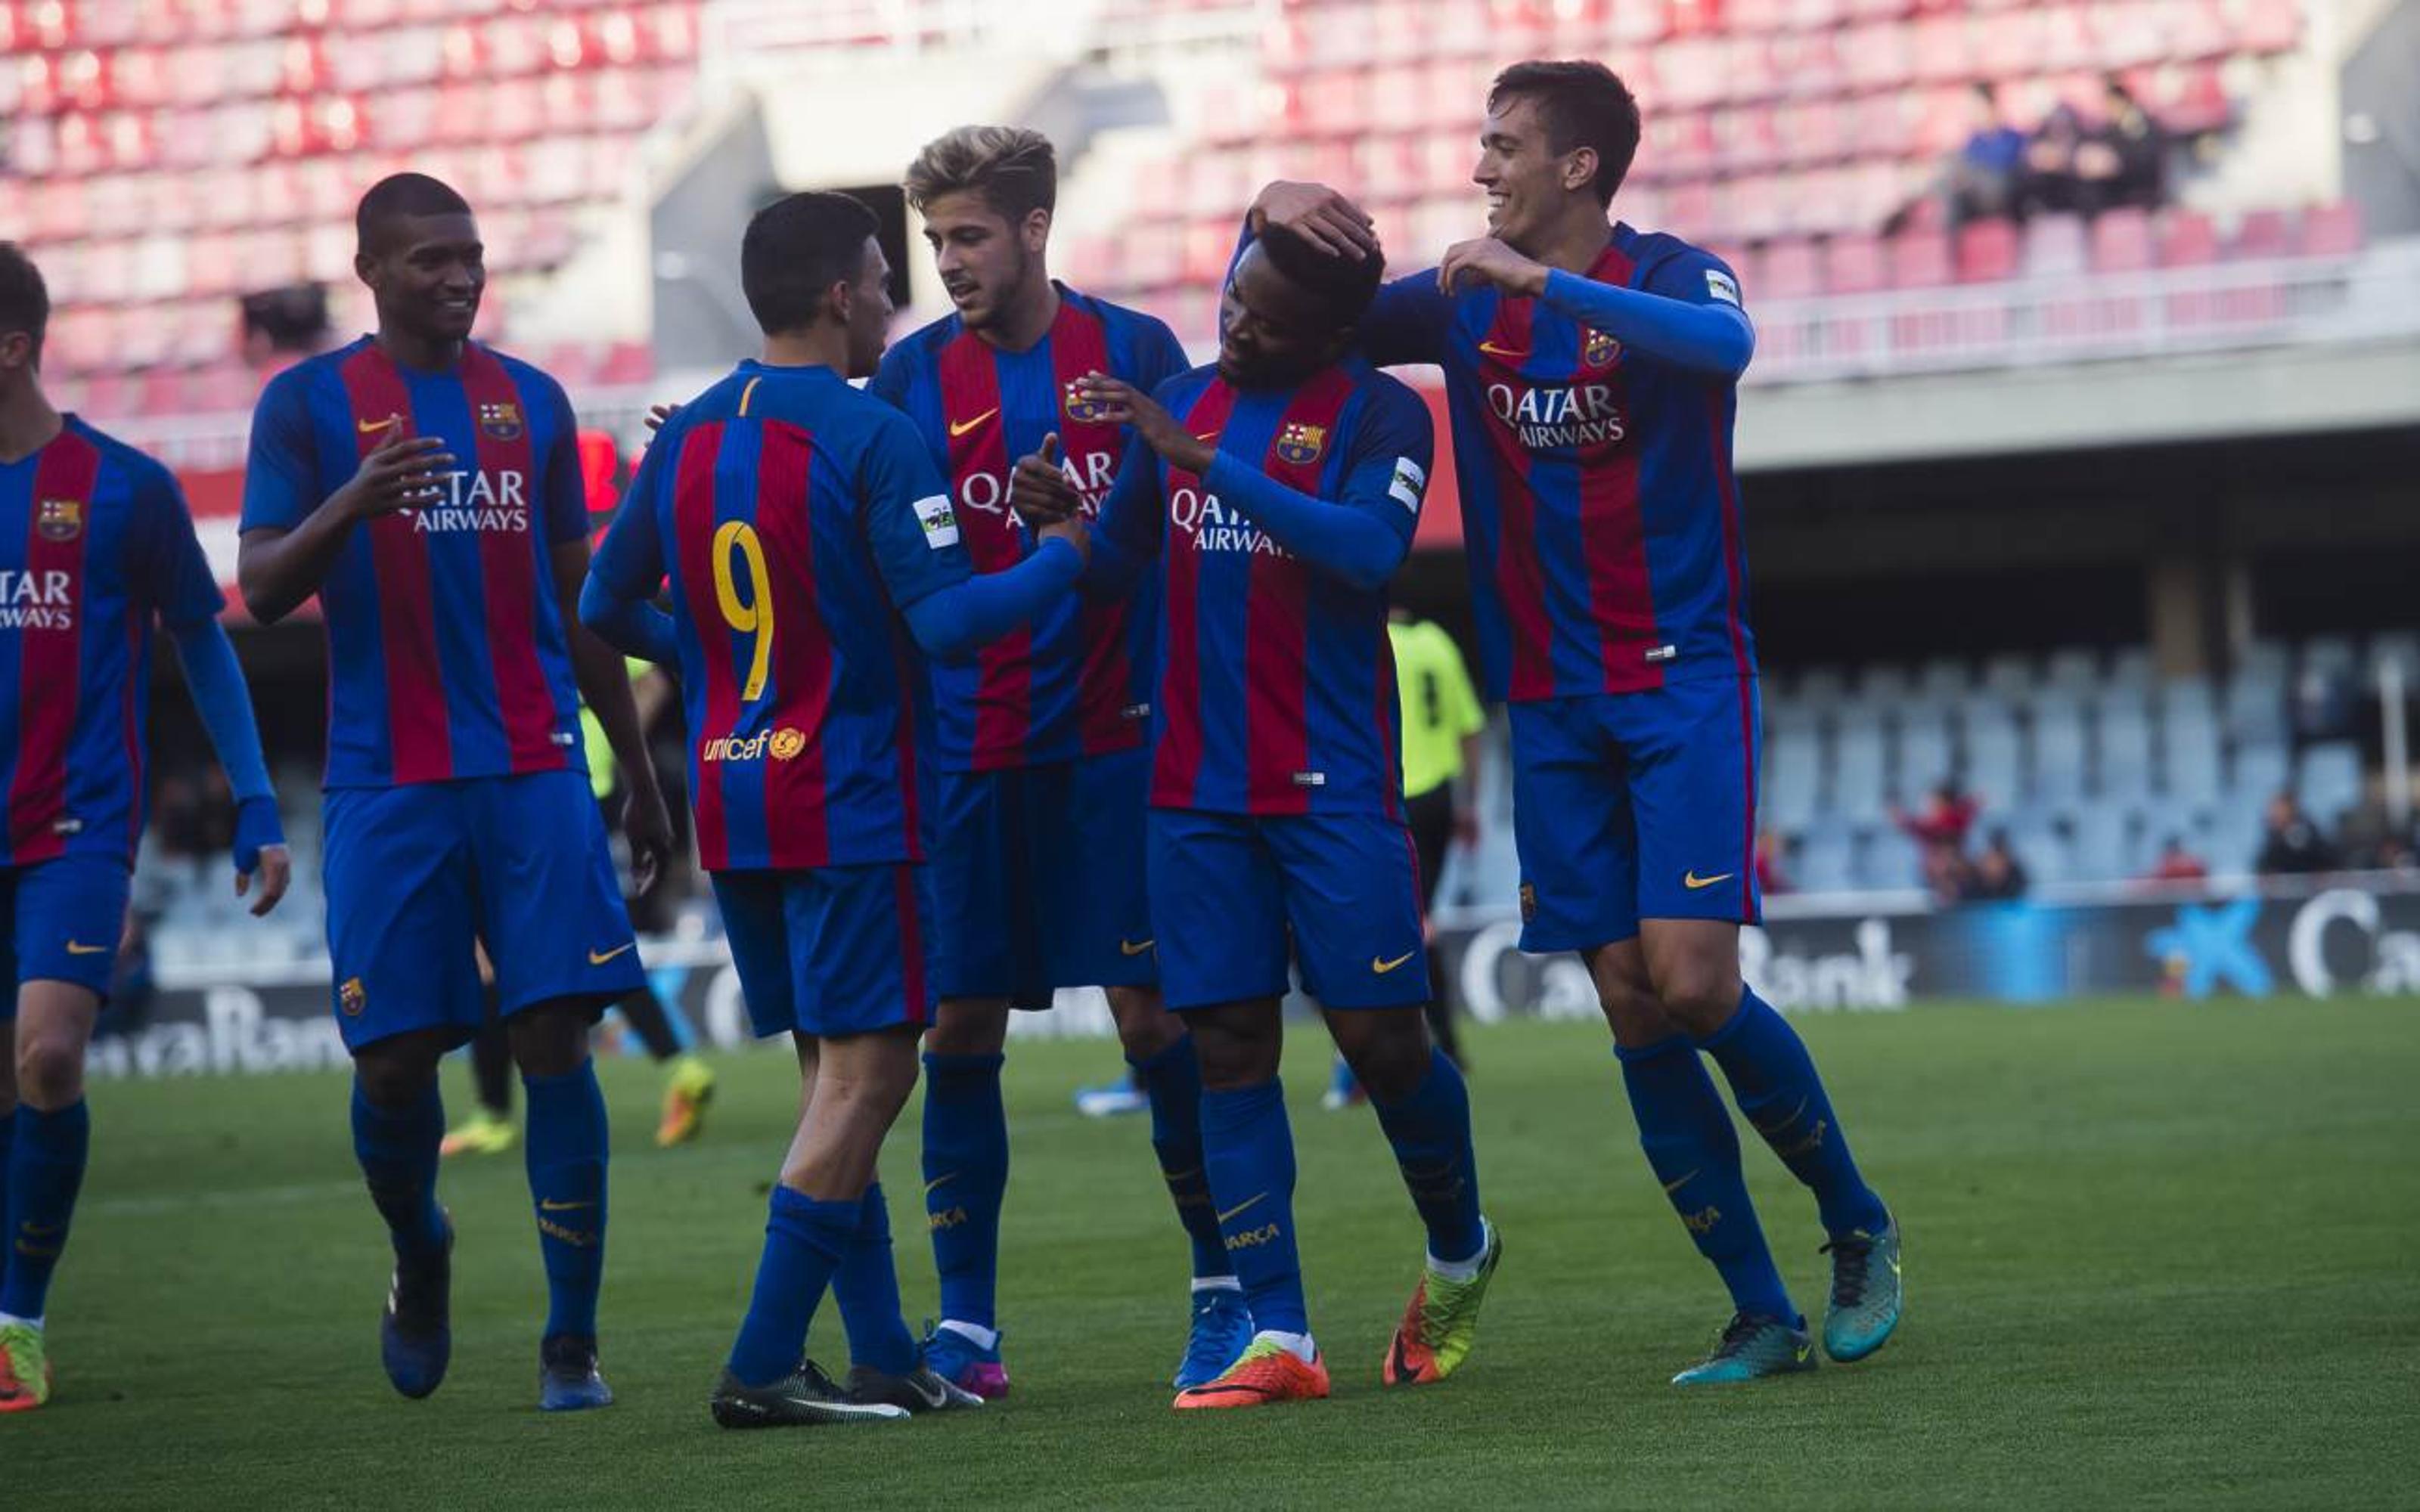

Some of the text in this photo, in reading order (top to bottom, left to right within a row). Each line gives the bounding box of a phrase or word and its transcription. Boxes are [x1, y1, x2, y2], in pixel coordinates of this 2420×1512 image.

[1488, 383, 1620, 429] QATAR
[1519, 417, 1625, 448] AIRWAYS
[399, 469, 525, 516] TAR
[961, 451, 1114, 515] QAR
[414, 508, 528, 533] AIRWAYS
[0, 606, 72, 631] WAYS
[712, 519, 774, 702] 9
[704, 730, 771, 761] unicef
